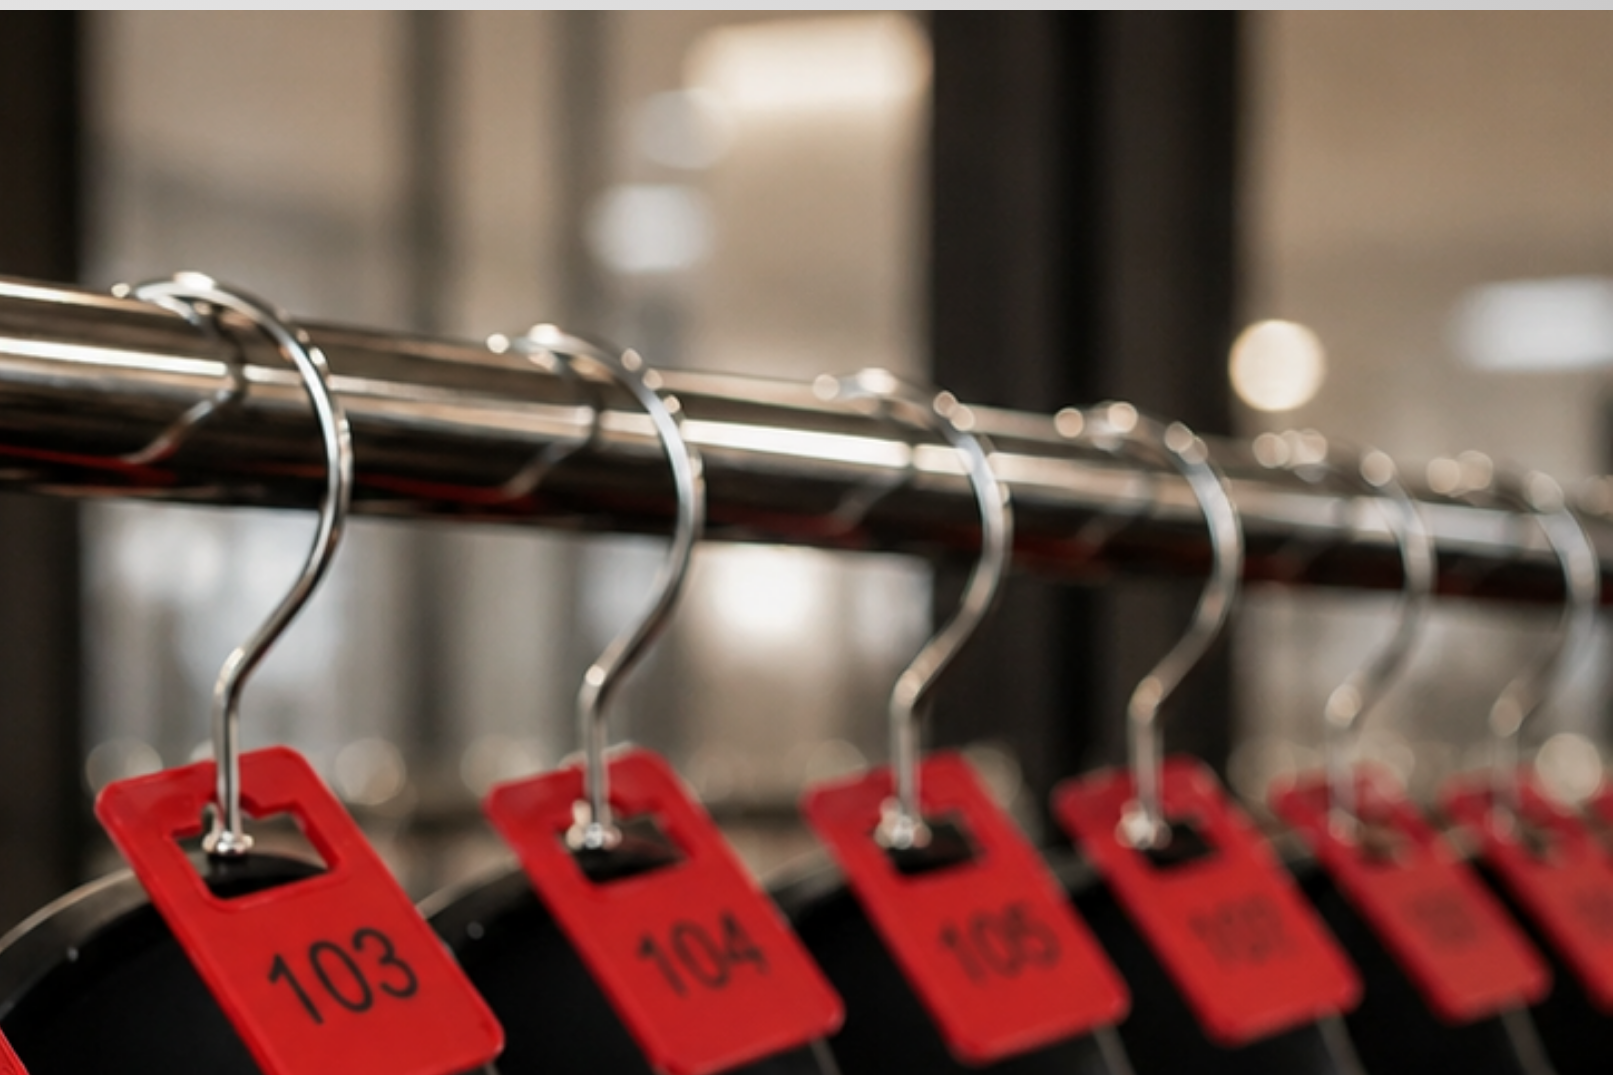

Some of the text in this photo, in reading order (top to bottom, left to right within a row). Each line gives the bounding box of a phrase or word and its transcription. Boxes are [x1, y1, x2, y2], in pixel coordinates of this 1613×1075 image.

[266, 926, 420, 1025] 103
[635, 911, 769, 996] 104
[938, 901, 1061, 984] 105
